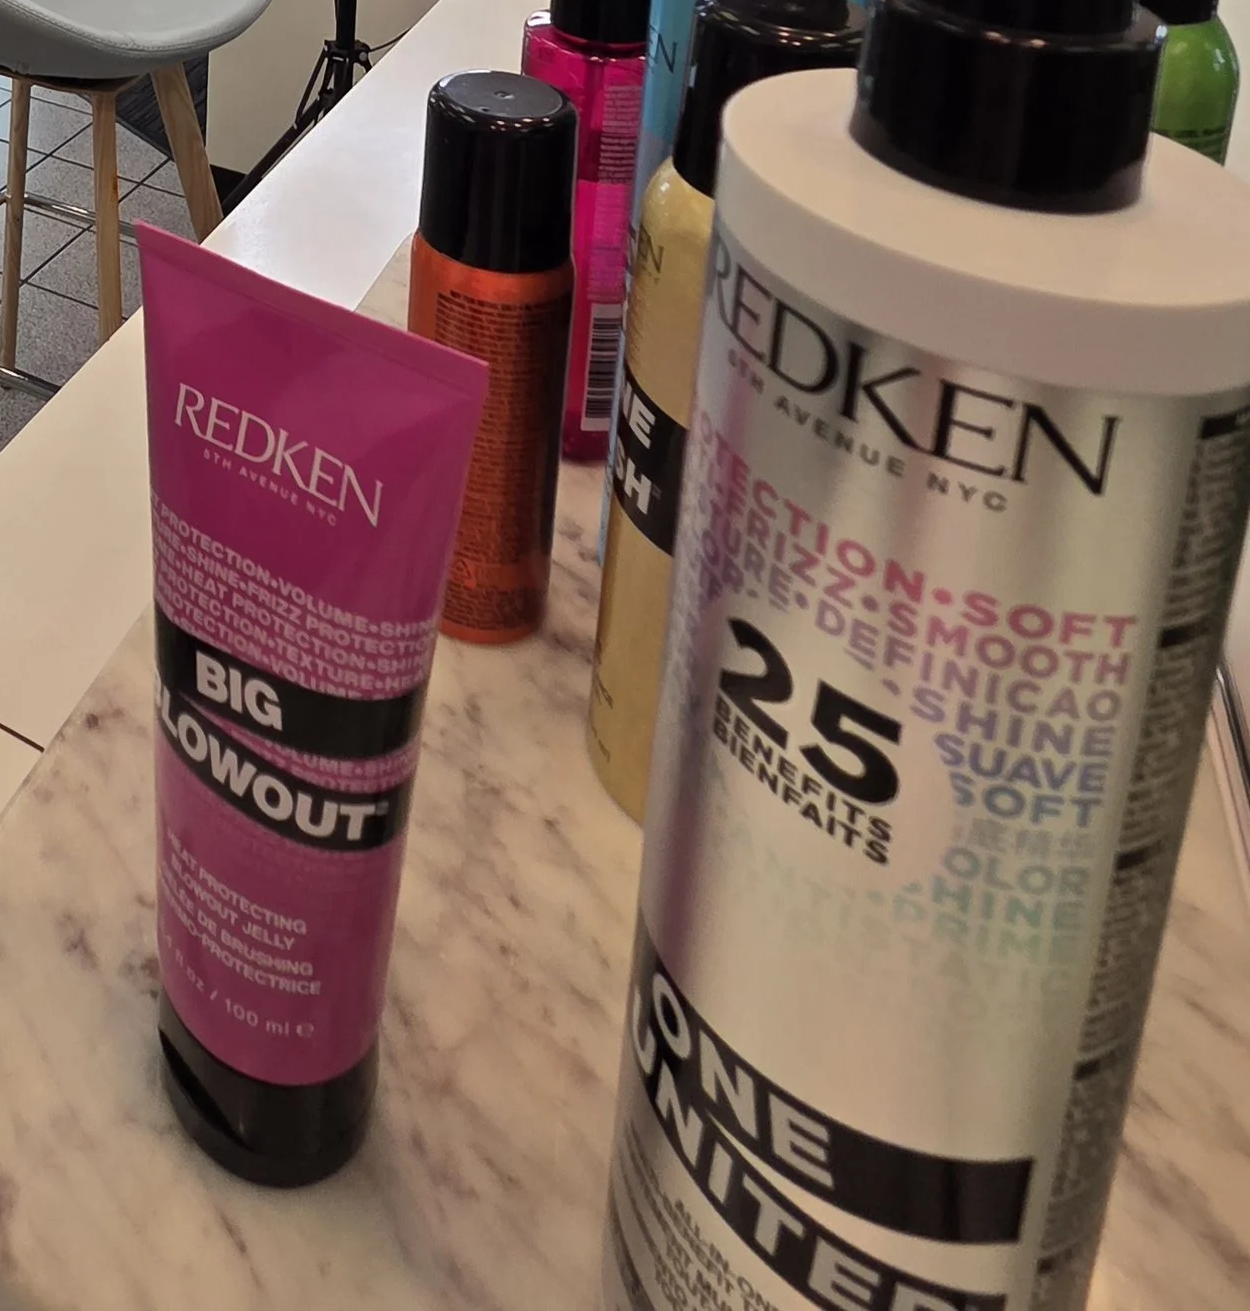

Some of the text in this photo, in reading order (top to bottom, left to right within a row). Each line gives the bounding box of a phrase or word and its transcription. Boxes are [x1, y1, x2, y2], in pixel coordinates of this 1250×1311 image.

[716, 237, 1122, 496] REDKEN
[174, 382, 383, 527] REDKEN
[774, 395, 906, 477] AVENUE
[926, 471, 1008, 513] NYC
[239, 465, 299, 506] AVENUE
[305, 500, 337, 527] NYC
[701, 412, 925, 604] OTECTION
[961, 591, 1139, 649] SOFT
[161, 503, 270, 585] PROTECTION
[278, 577, 369, 634] VOLUME
[187, 545, 241, 589] SHINE
[248, 581, 302, 626] FRIZZ
[182, 560, 228, 600] HEAT
[232, 592, 366, 671] PROTECTION
[887, 601, 1131, 685] SMOOTH
[196, 650, 283, 731] BIG
[275, 638, 374, 690] TEXTURE
[385, 669, 424, 692] HEA
[719, 617, 902, 806] 25
[909, 687, 1116, 758] SHINE
[712, 714, 889, 867] BIENFAITS
[715, 693, 893, 843] BENEFITS
[933, 732, 1108, 794] SUAVE
[950, 771, 1103, 829] SOFT
[199, 866, 307, 936] PROTECTING
[905, 874, 1085, 929] HINE
[944, 847, 1091, 897] OLOR
[197, 909, 217, 936] DE
[220, 928, 313, 976] BRUSHING
[242, 921, 295, 951] JELLY
[225, 998, 258, 1027] 100
[265, 1020, 290, 1035] ml
[652, 973, 835, 1190] ONE
